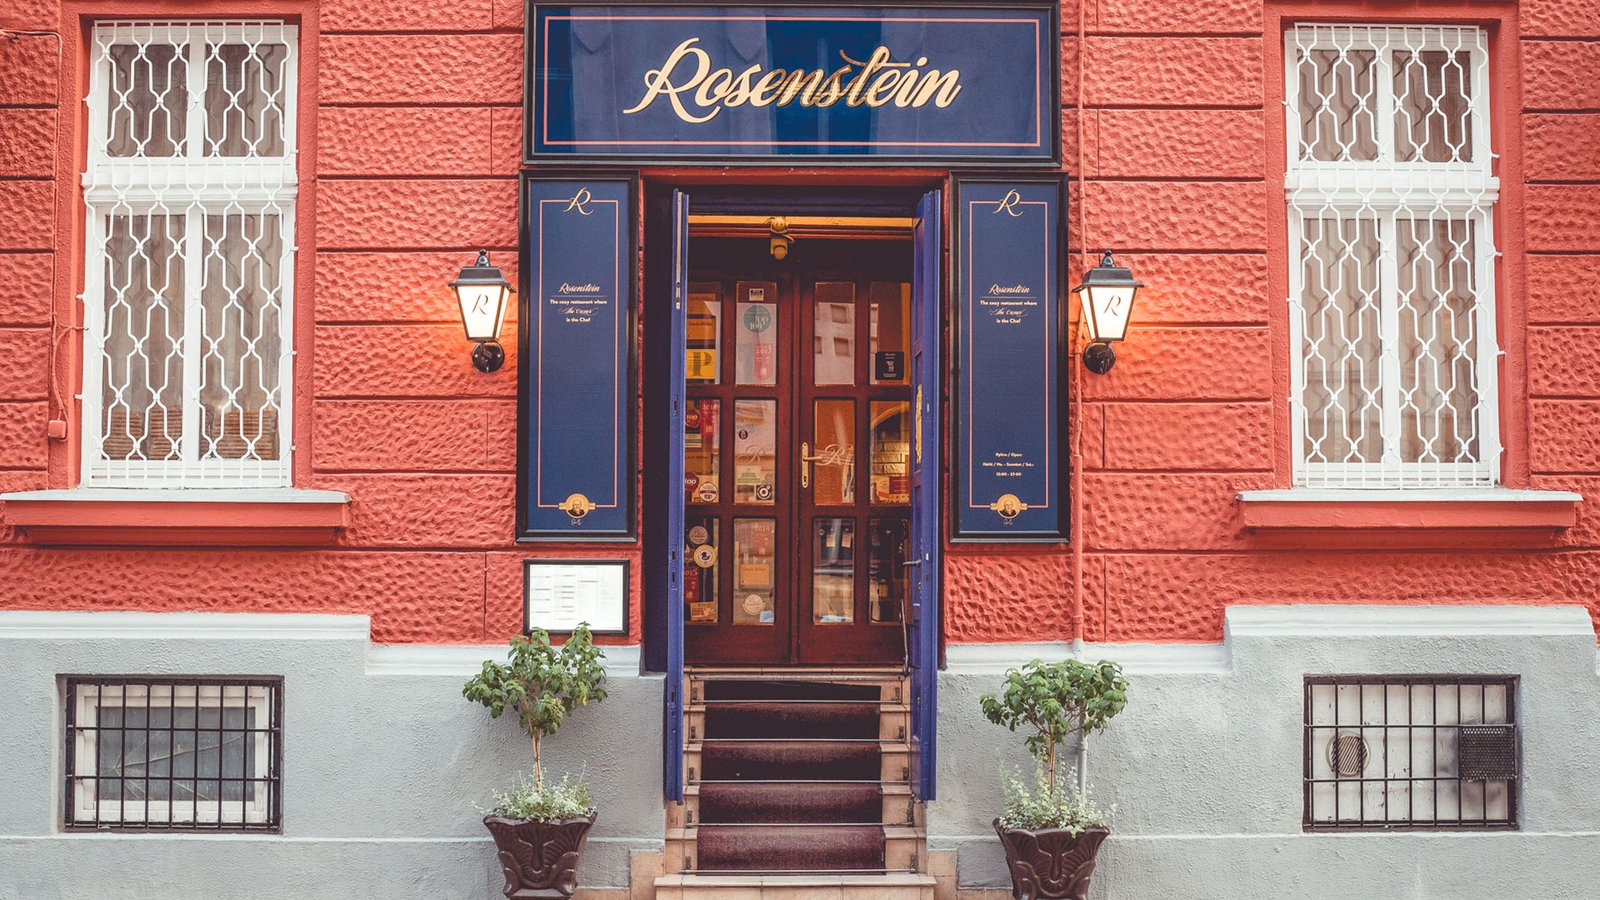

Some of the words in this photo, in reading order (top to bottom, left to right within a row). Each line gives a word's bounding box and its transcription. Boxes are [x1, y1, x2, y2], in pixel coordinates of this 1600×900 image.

[623, 37, 962, 123] Rosenstein
[563, 187, 594, 215] R
[993, 188, 1024, 217] R
[559, 282, 600, 294] Rosenstein
[989, 283, 1030, 295] Rosenstein
[472, 294, 488, 315] R
[1103, 295, 1121, 316] R
